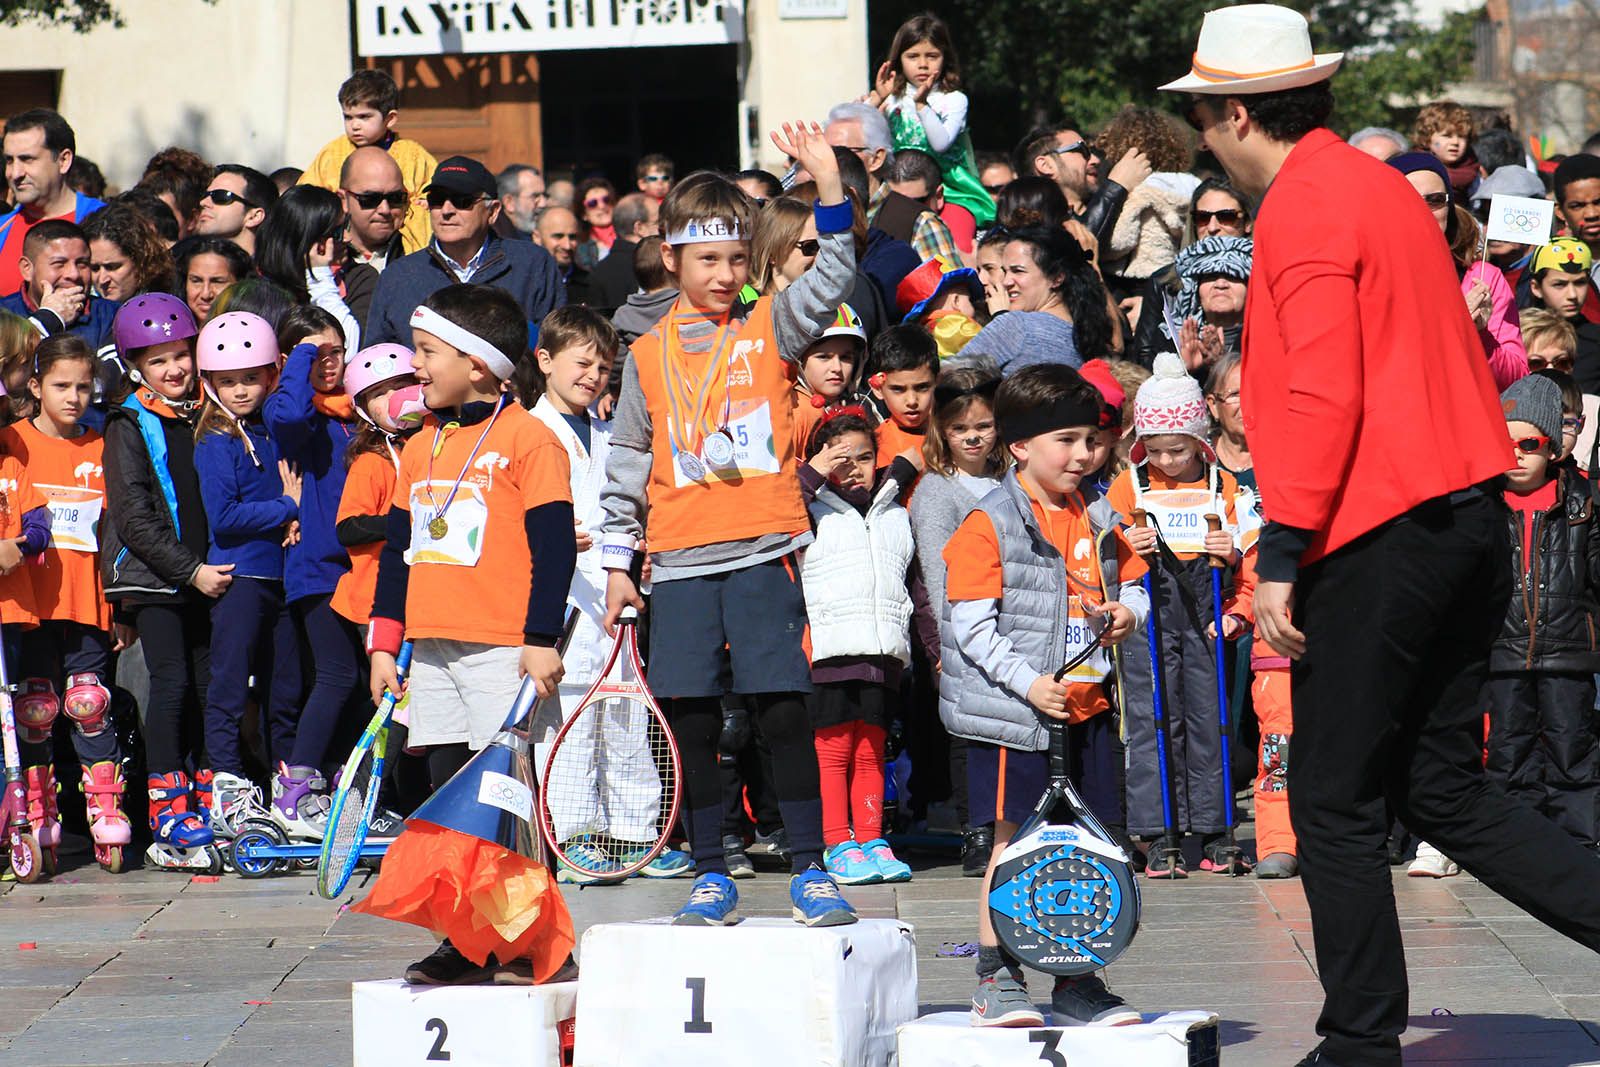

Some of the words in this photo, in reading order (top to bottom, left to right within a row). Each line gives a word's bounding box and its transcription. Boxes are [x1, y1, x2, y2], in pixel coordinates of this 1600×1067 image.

[1167, 512, 1198, 528] 2210
[1038, 955, 1092, 963] DUNLOP
[684, 977, 713, 1033] 1
[425, 1018, 451, 1061] 2
[1029, 1030, 1068, 1067] 3
